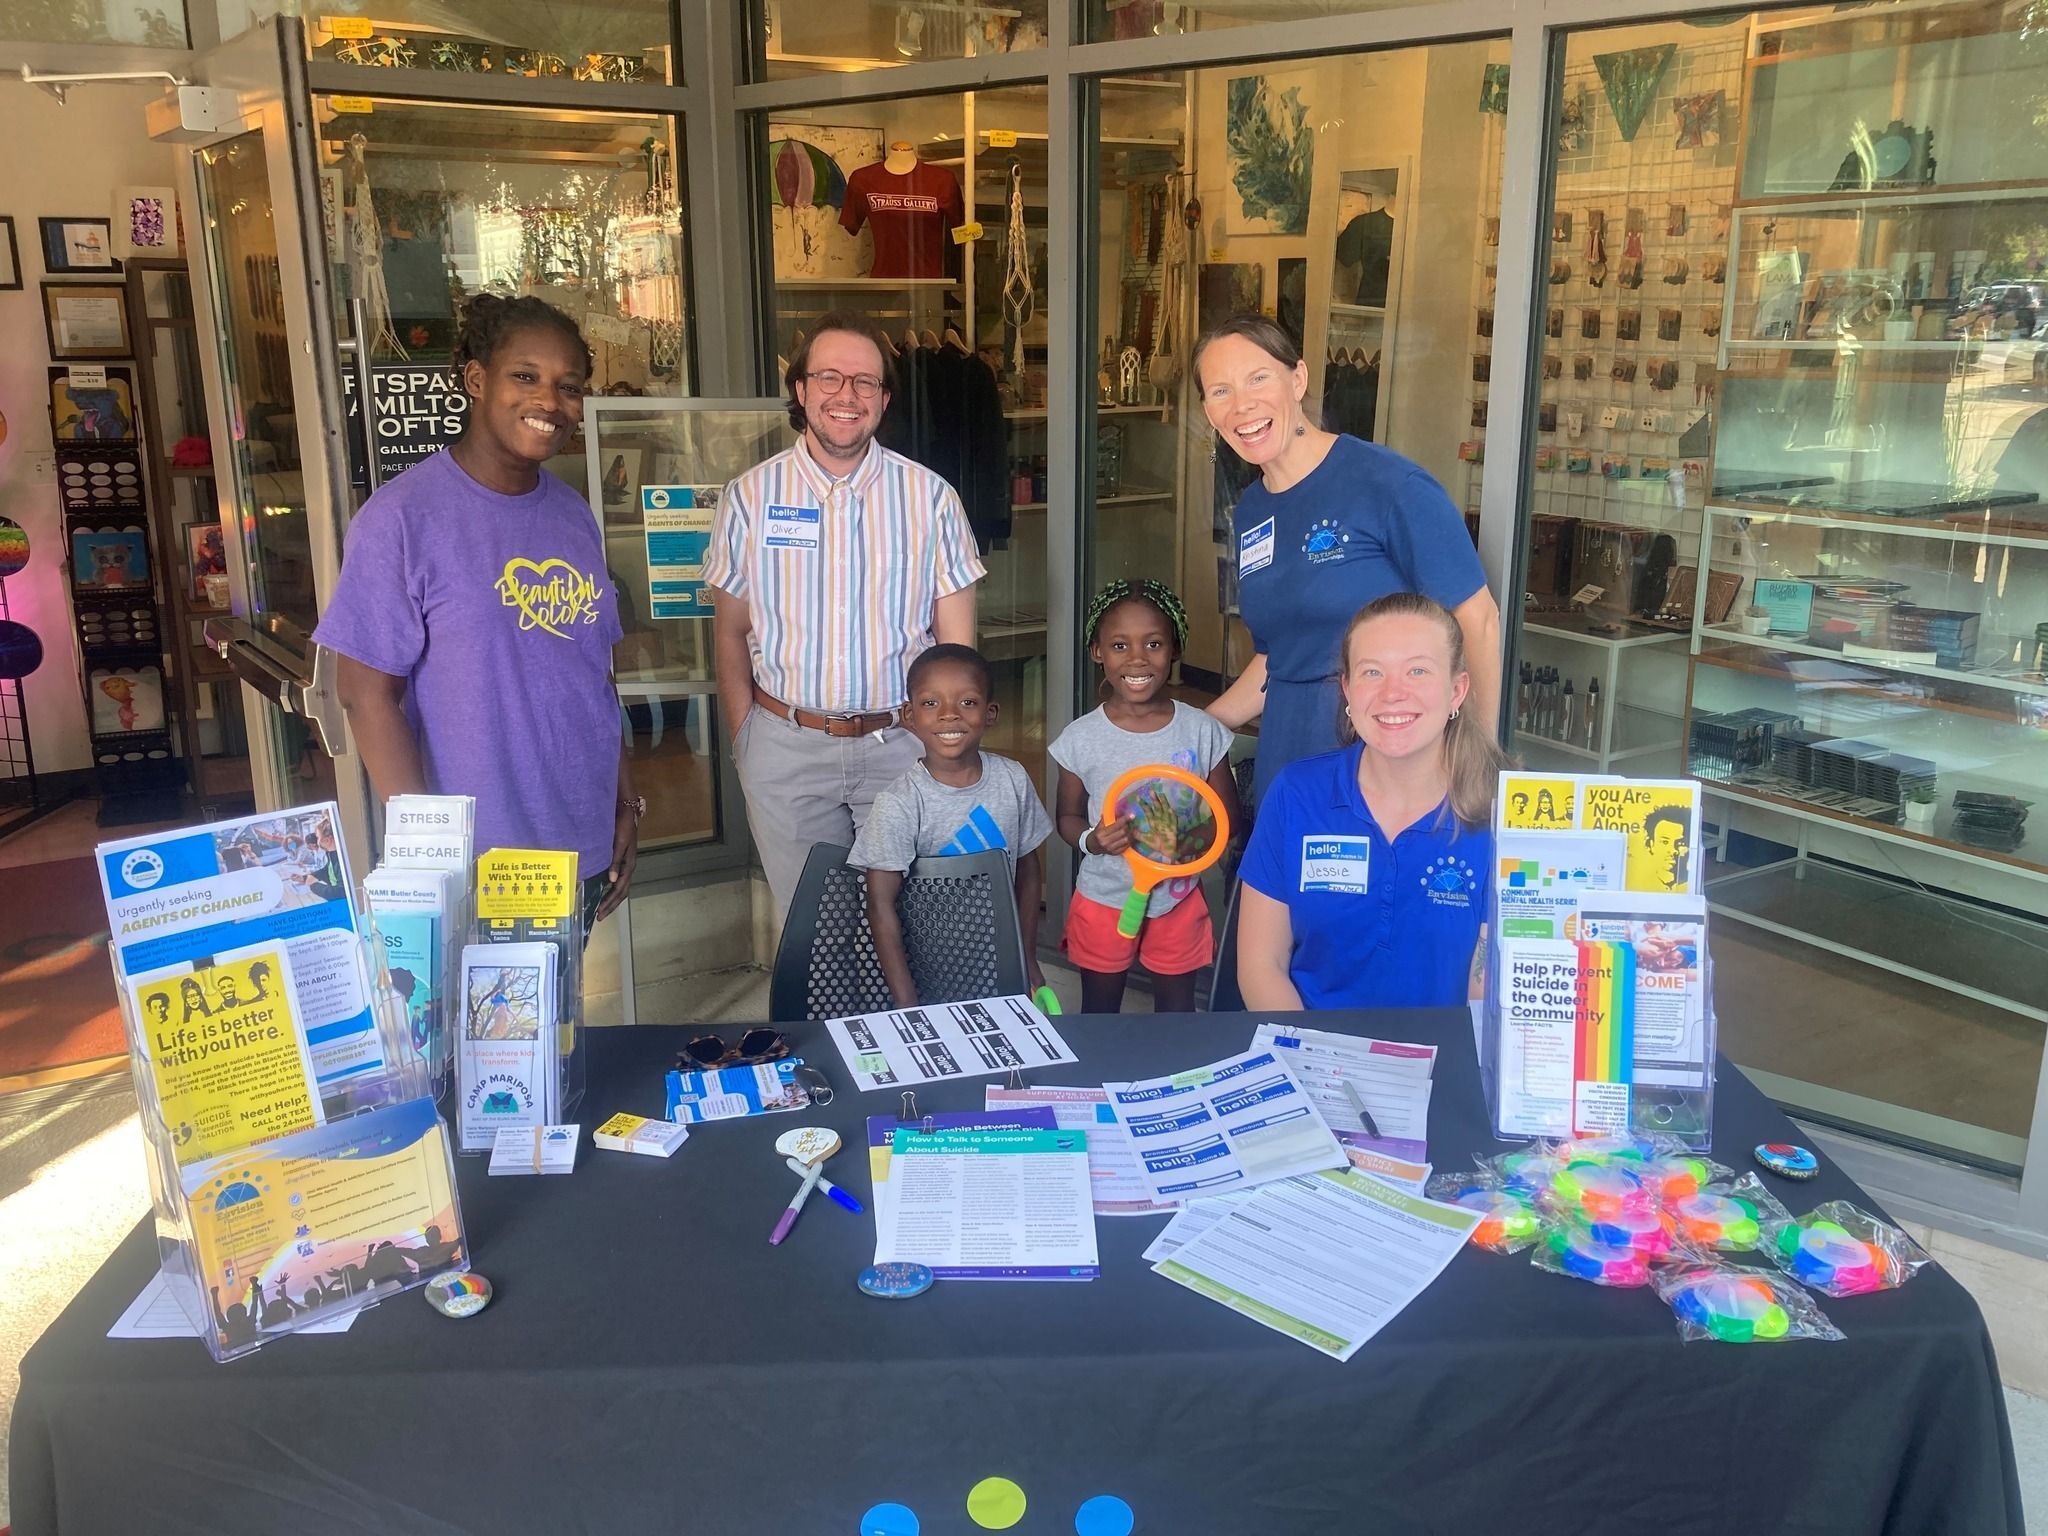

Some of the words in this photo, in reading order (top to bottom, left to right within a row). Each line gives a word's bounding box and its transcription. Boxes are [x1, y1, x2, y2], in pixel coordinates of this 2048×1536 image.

[871, 195, 902, 208] STRAUSS
[903, 197, 936, 210] GALLERY
[380, 443, 445, 454] GALLERY
[771, 508, 799, 517] hello!
[771, 524, 801, 535] Oliver
[494, 573, 603, 607] Beautiful
[1588, 788, 1620, 804] you
[1623, 788, 1651, 804] Are
[400, 813, 450, 824] STRESS
[1593, 803, 1624, 819] Not
[1593, 818, 1641, 833] Alone
[390, 847, 461, 858] SELF-CARE
[1309, 843, 1341, 856] hello!
[491, 863, 509, 871] Life
[511, 863, 519, 871] is
[521, 862, 551, 870] Better
[1306, 862, 1350, 878] Jessie
[488, 873, 512, 881] With
[368, 889, 389, 897] NAMI
[412, 890, 436, 898] County
[1501, 889, 1539, 897] COMMUNITY
[117, 899, 166, 918] Urgently
[169, 889, 213, 906] seeking
[121, 911, 179, 934] AGENTS
[180, 906, 200, 919] OF
[200, 891, 264, 915] CHANGE!
[1513, 962, 1549, 977] Help
[1552, 964, 1612, 978] Prevent
[311, 972, 337, 985] ABOUT
[1512, 976, 1569, 990] Suicide
[1574, 980, 1588, 992] in
[1512, 991, 1537, 1003] the
[1541, 992, 1588, 1006] Queer
[971, 1013, 994, 1030] hello!
[1511, 1005, 1605, 1024] Community
[156, 1028, 198, 1052] Life
[201, 1023, 217, 1040] is
[220, 1008, 274, 1034] better
[912, 1021, 934, 1039] hello!
[159, 1047, 199, 1069] with
[199, 1038, 231, 1060] you
[233, 1025, 284, 1049] here.
[851, 1030, 873, 1049] hello!
[213, 1062, 228, 1071] that
[229, 1054, 255, 1066] suicide
[256, 1047, 284, 1059] became
[285, 1042, 296, 1050] the
[933, 1054, 956, 1073] hello!
[200, 1072, 222, 1082] cause
[232, 1062, 253, 1073] death
[262, 1054, 282, 1064] Black
[283, 1050, 298, 1059] kids
[202, 1080, 216, 1089] and
[217, 1077, 229, 1086] the
[230, 1071, 247, 1082] third
[248, 1066, 270, 1076] cause
[216, 1082, 237, 1093] Black
[238, 1076, 258, 1086] teens
[259, 1070, 277, 1081] aged
[229, 1088, 250, 1098] There
[259, 1078, 277, 1089] hope
[250, 1081, 306, 1102] withyouhere.org
[467, 1079, 487, 1109] CAMP
[489, 1074, 534, 1109] MARIPOSA
[1121, 1087, 1162, 1102] hello!
[240, 1104, 272, 1121] Need
[274, 1094, 308, 1111] Help?
[1220, 1092, 1263, 1114] hello!
[251, 1117, 274, 1129] CALL
[275, 1112, 288, 1121] OR
[289, 1105, 312, 1117] TEXT
[267, 1124, 281, 1133] the
[283, 1114, 313, 1128] 24-hour
[973, 1123, 1021, 1132] Between
[1135, 1120, 1179, 1135] hello!
[906, 1135, 932, 1143] How
[947, 1135, 968, 1143] Talk
[970, 1135, 982, 1143] to
[983, 1135, 1034, 1143] Someone
[905, 1146, 939, 1154] About
[1151, 1154, 1196, 1170] hello!
[215, 1199, 264, 1221] Envision
